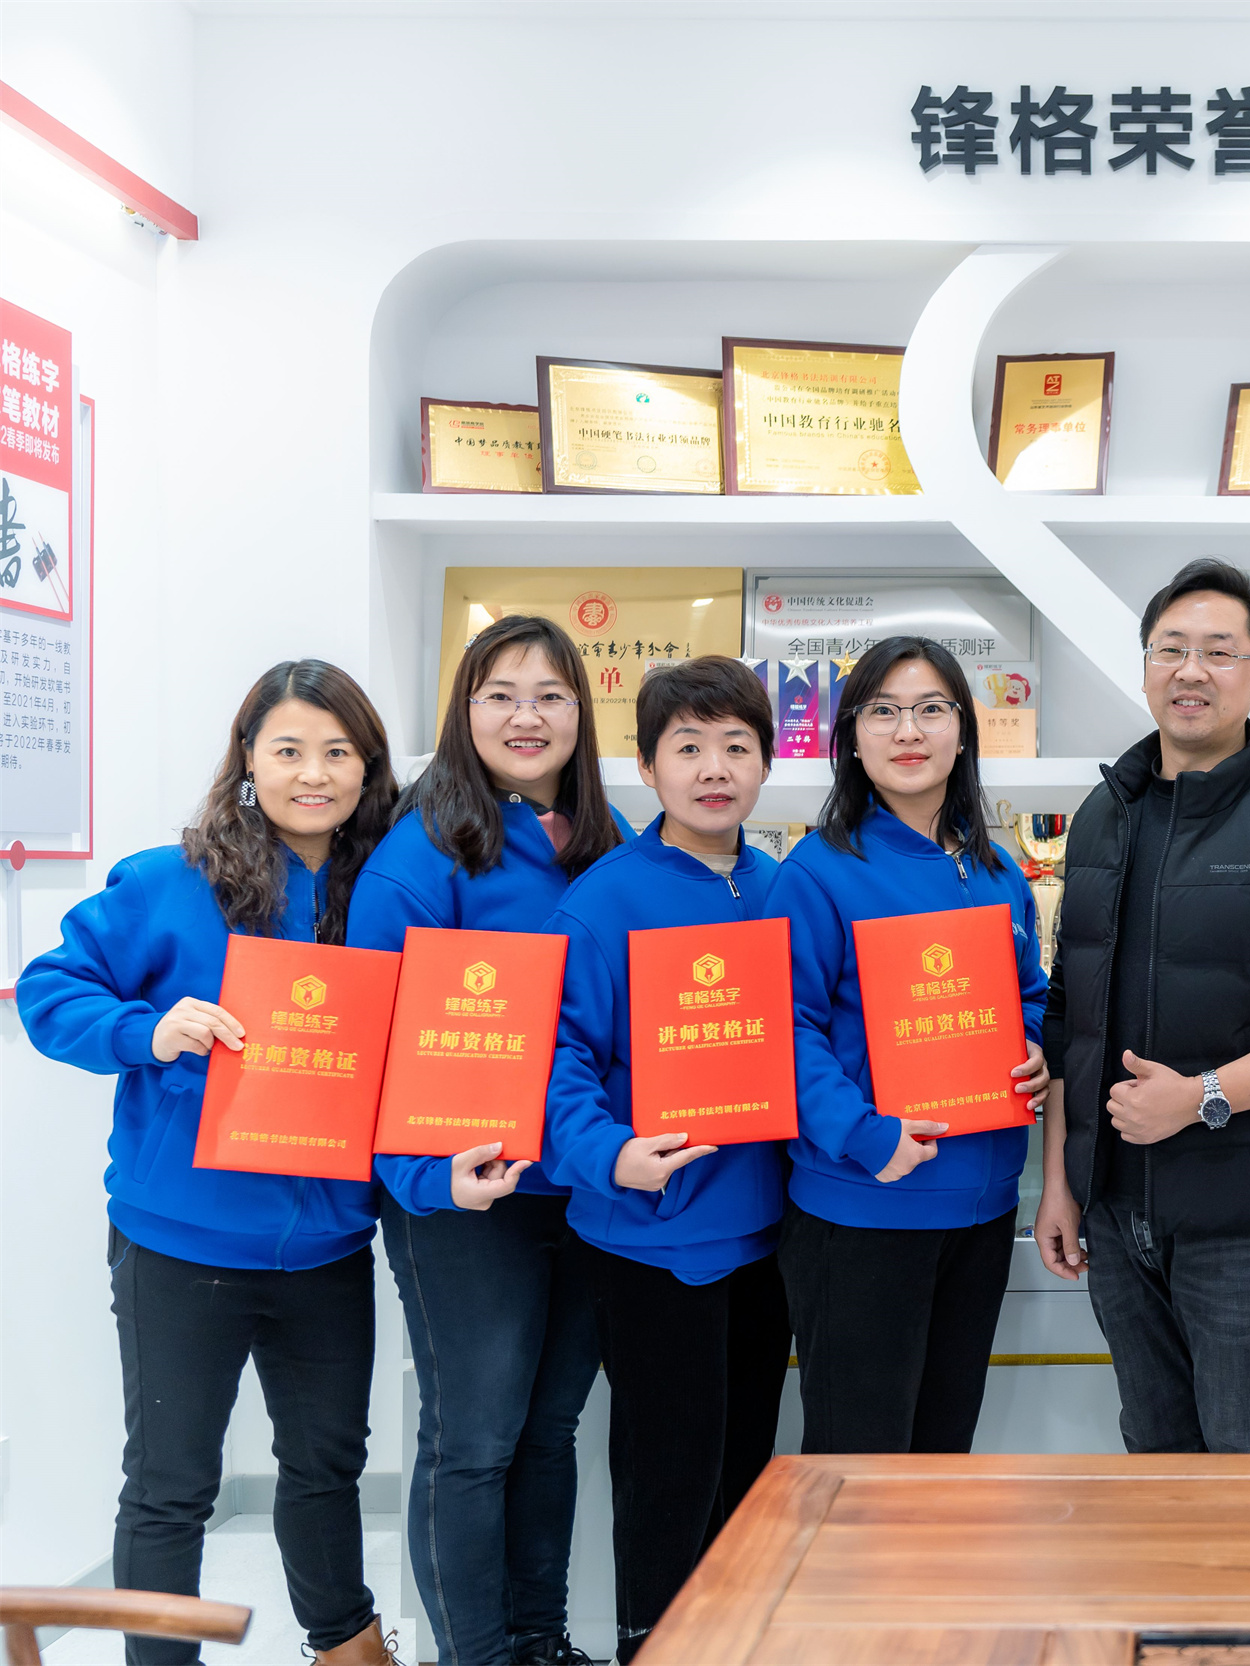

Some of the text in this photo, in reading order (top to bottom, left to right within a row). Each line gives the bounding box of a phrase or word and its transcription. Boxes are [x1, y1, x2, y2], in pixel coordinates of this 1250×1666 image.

[0, 338, 59, 393] 格练字
[0, 384, 59, 438] 笔教材
[596, 667, 623, 693] 单
[678, 987, 741, 1006] 锋格练字
[910, 977, 971, 998] 锋格练字
[445, 997, 508, 1014] 锋格练字
[271, 1011, 339, 1028] 锋格练字
[894, 1006, 998, 1039] 讲师资格证
[418, 1030, 526, 1052] 讲师资格证
[658, 1018, 765, 1046] 讲师资格证
[924, 1032, 964, 1042] QUALIFICATION
[964, 1027, 998, 1036] CERTIFICATE
[687, 1042, 729, 1050] QUALIFICATION
[730, 1038, 765, 1046] CERTIFICATE
[242, 1042, 358, 1071] 讲师资格证
[660, 1101, 769, 1120] 北京锋格书法培训有限公司
[904, 1090, 1008, 1114] 北京锋格书法培训有限公司
[407, 1116, 517, 1130] 北京锋格书法培训有限公司
[230, 1130, 346, 1149] 北京锋格书法培训有限公司
